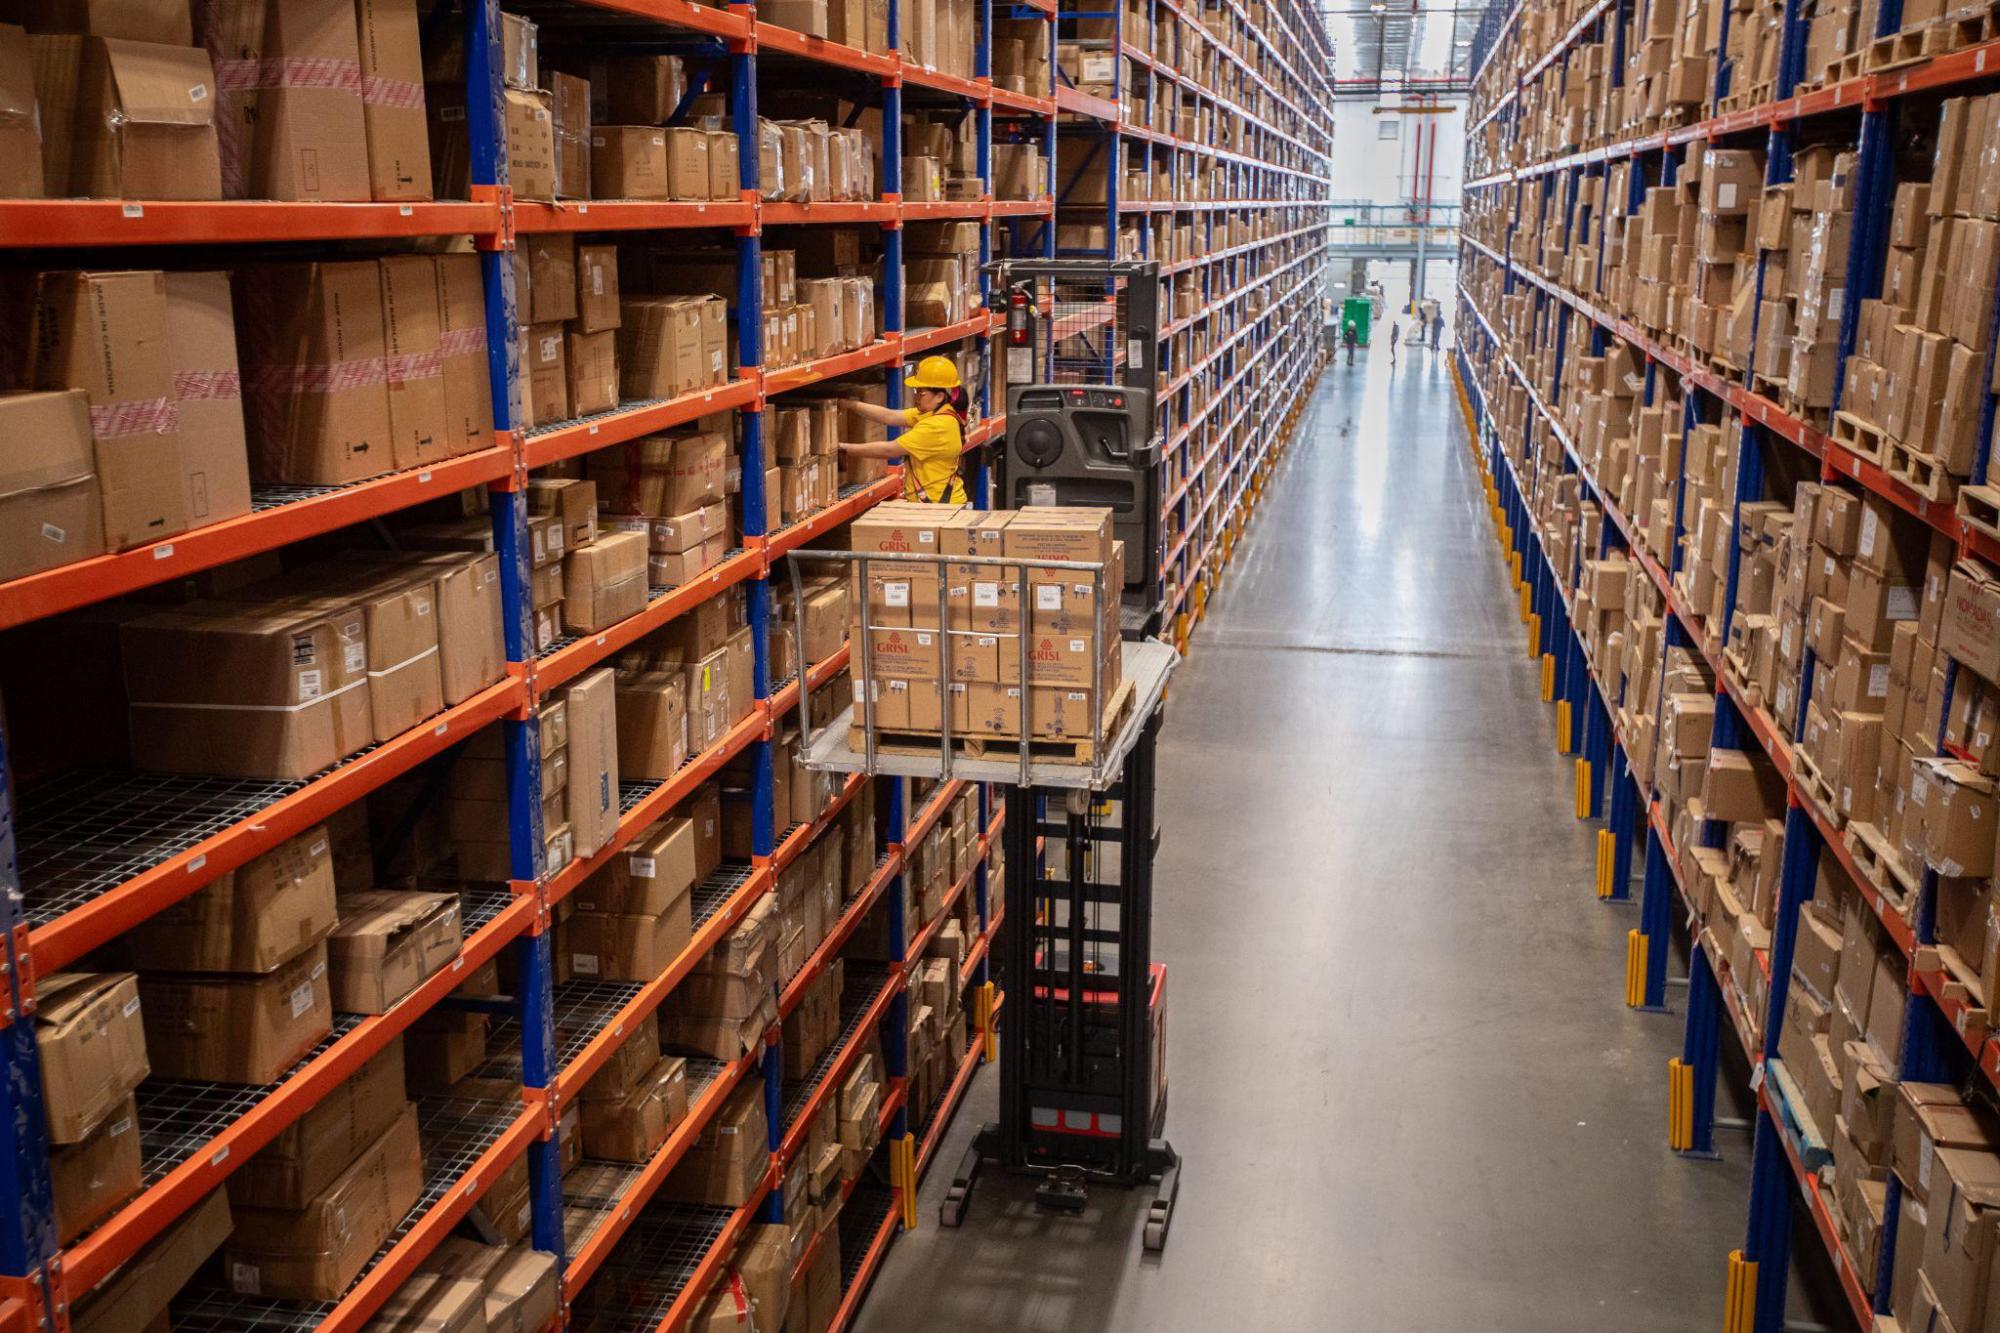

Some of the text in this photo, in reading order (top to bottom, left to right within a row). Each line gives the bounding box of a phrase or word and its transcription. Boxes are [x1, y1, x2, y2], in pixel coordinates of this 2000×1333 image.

[879, 541, 911, 552] GRISI
[877, 643, 909, 653] GRISI
[1028, 650, 1060, 661] GRISI
